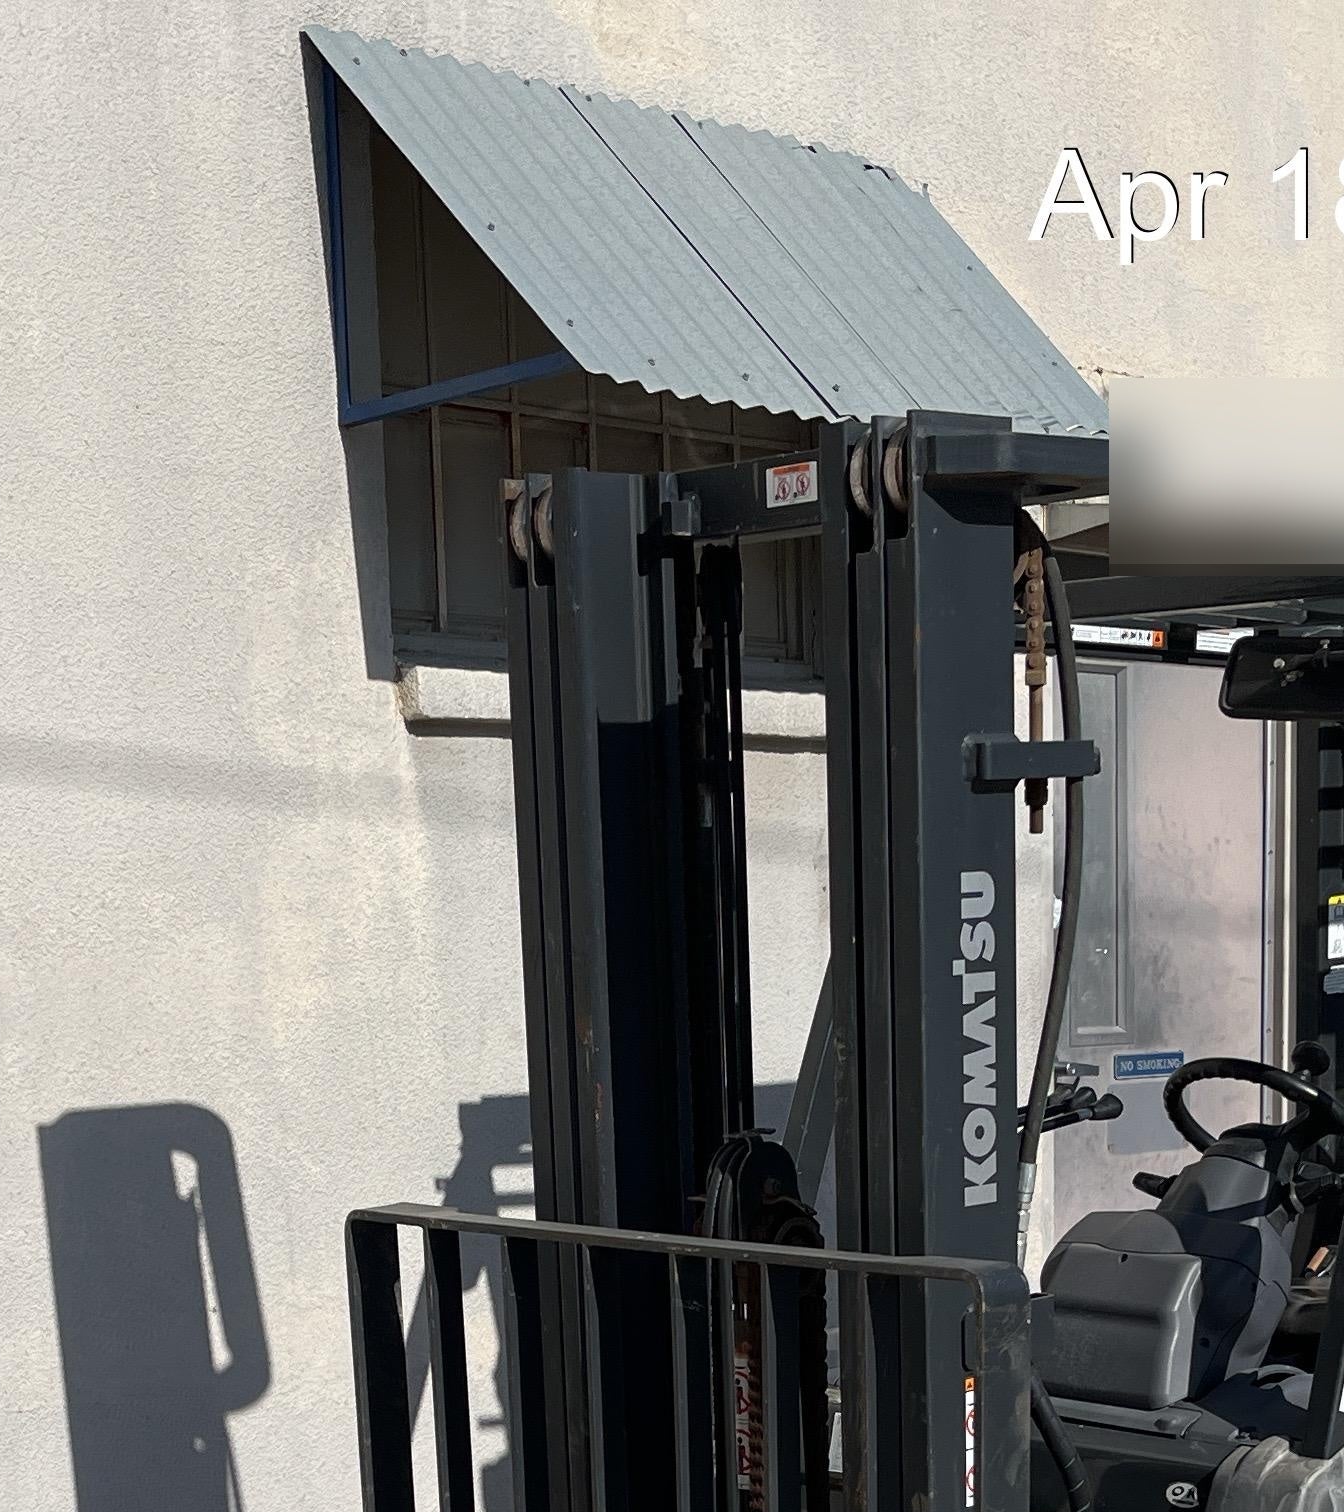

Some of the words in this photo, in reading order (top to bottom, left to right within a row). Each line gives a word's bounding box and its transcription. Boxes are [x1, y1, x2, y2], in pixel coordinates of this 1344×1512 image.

[952, 870, 998, 1208] KOMATSU
[1120, 1060, 1134, 1073] NO
[1136, 1057, 1181, 1071] SMOKING
